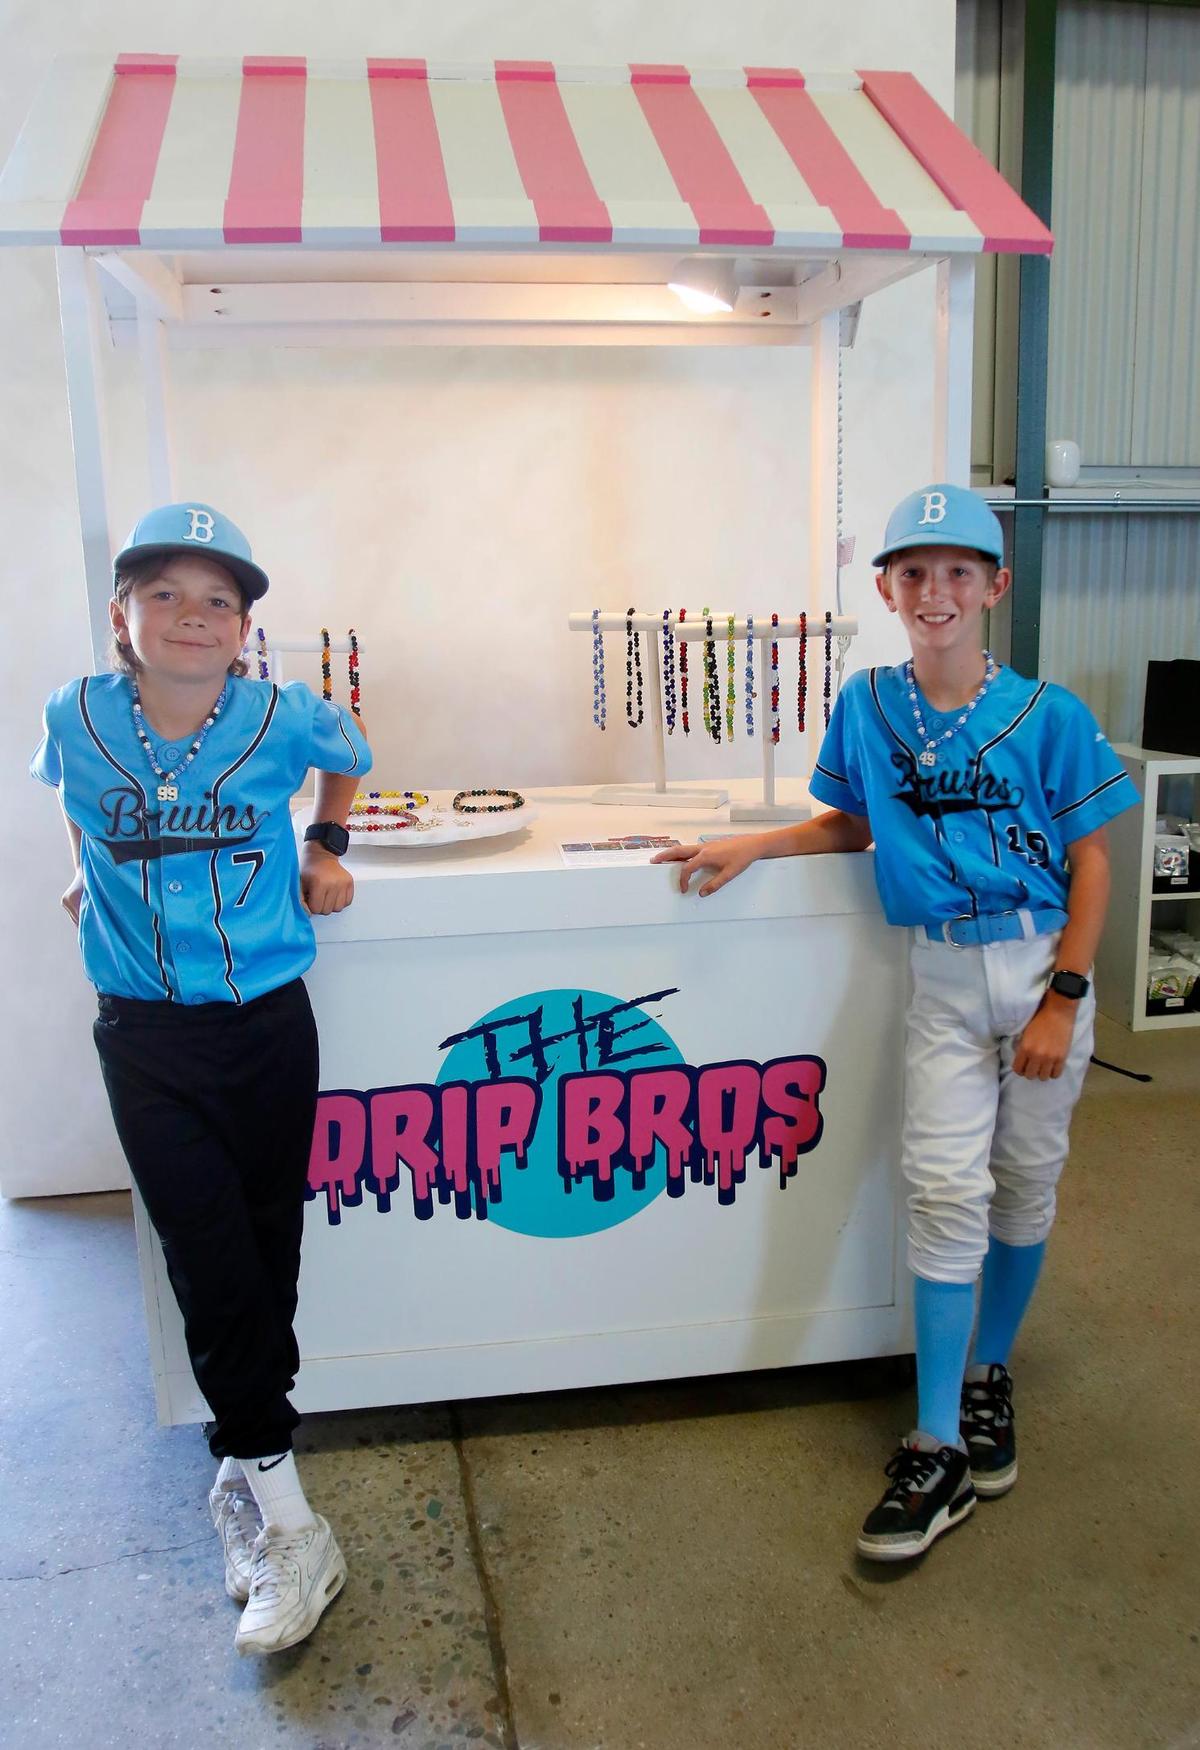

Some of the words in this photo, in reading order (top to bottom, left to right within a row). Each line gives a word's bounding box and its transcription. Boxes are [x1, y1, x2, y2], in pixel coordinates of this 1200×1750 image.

[182, 508, 216, 544] B
[918, 492, 948, 525] B
[99, 786, 271, 839] Bruins
[157, 786, 178, 802] 99
[1005, 823, 1052, 872] 19
[231, 849, 266, 909] 7
[438, 987, 682, 1083] THE
[304, 1076, 543, 1226] DRIP
[557, 1054, 827, 1206] BROS
